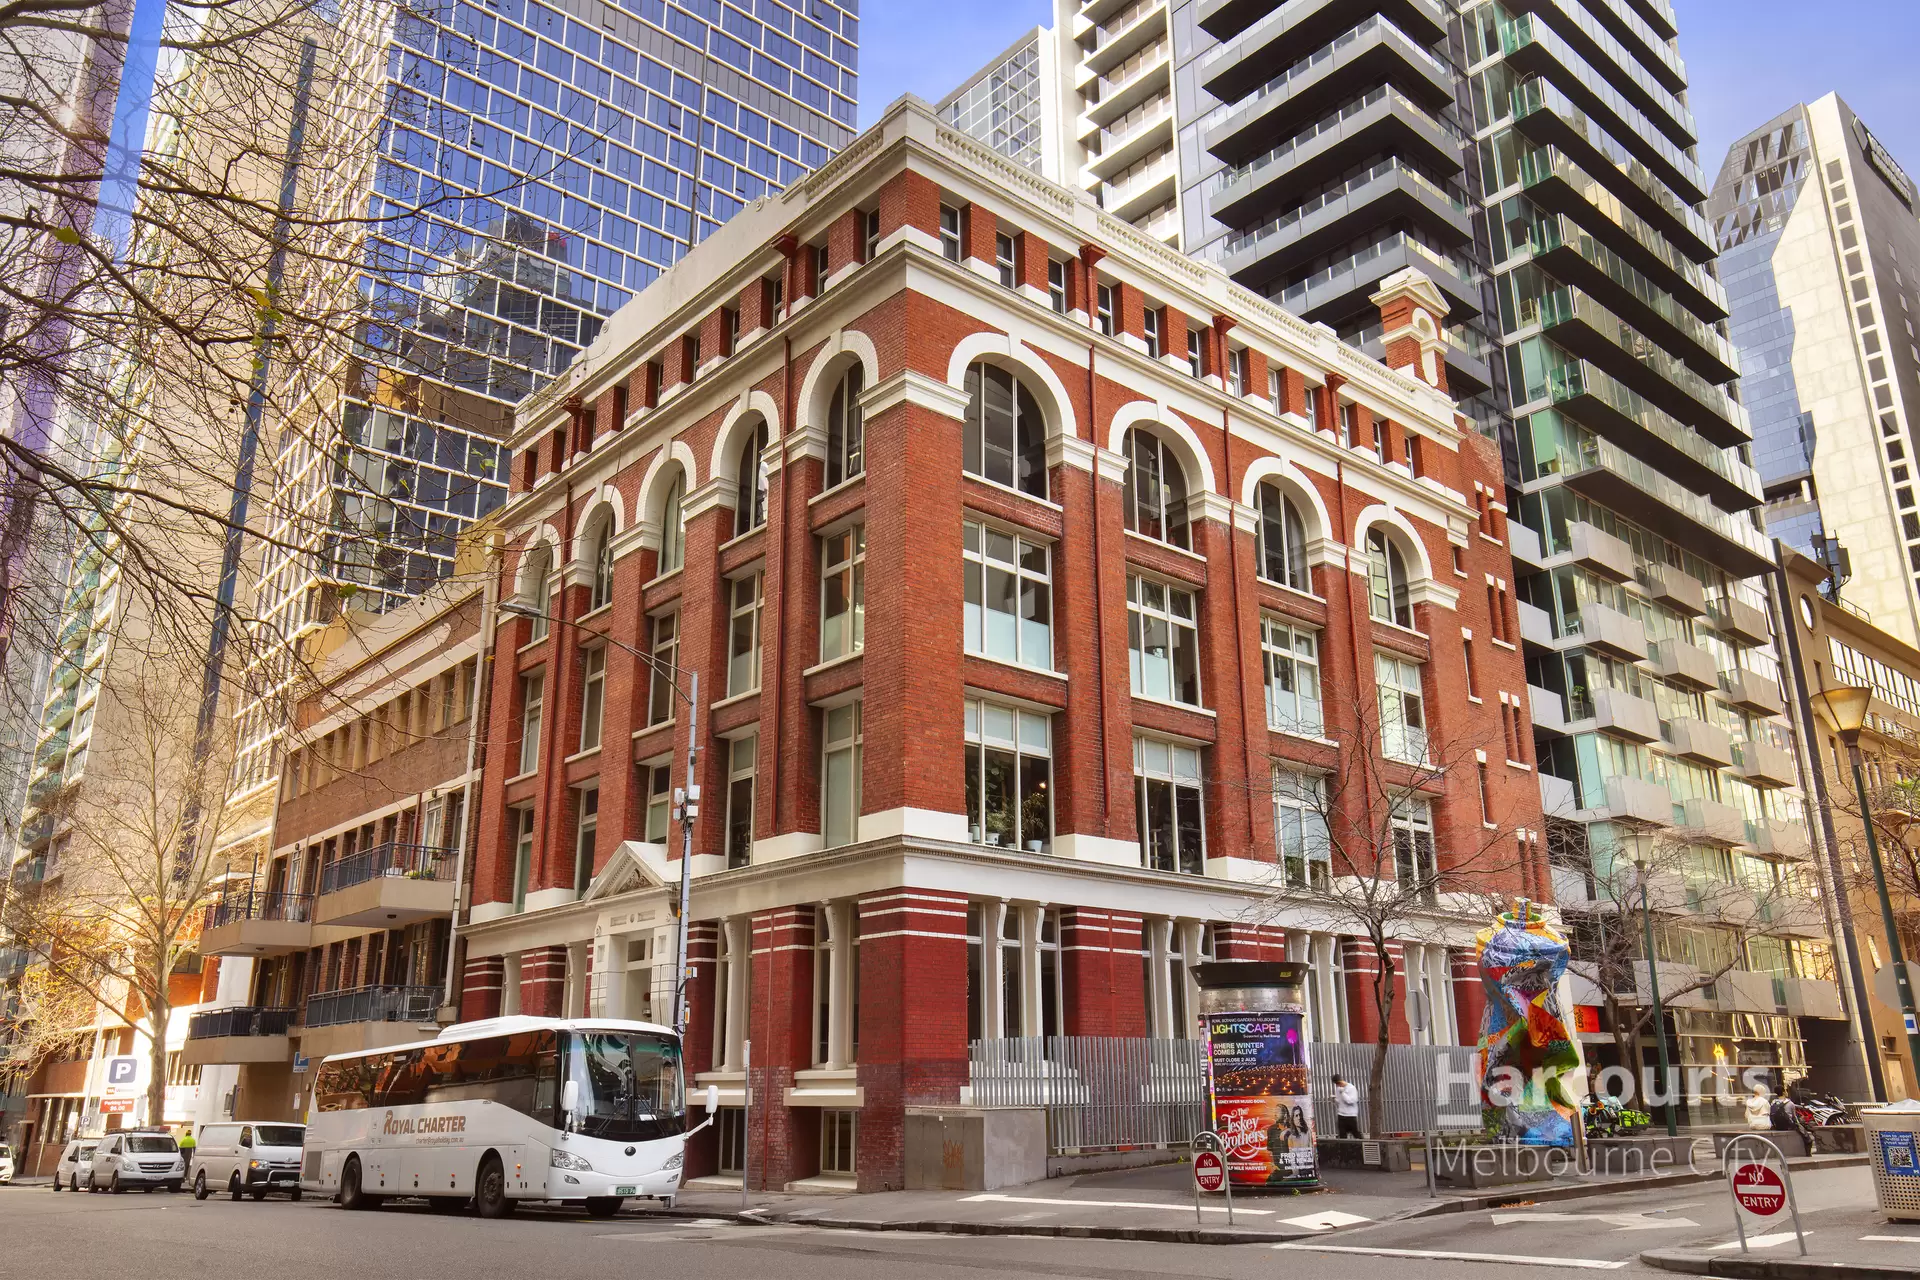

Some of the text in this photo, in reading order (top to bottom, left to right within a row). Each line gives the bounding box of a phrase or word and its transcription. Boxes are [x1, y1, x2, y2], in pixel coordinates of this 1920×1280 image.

[1212, 1023, 1276, 1034] LIGHTSCAPE
[1237, 1107, 1249, 1116] The
[384, 1110, 466, 1135] ROYAL CHARTER
[1221, 1114, 1259, 1133] Teskey
[1203, 1159, 1213, 1167] NO
[1200, 1175, 1220, 1185] ENTRY
[1749, 1172, 1765, 1183] NO
[1743, 1196, 1779, 1208] ENTRY
